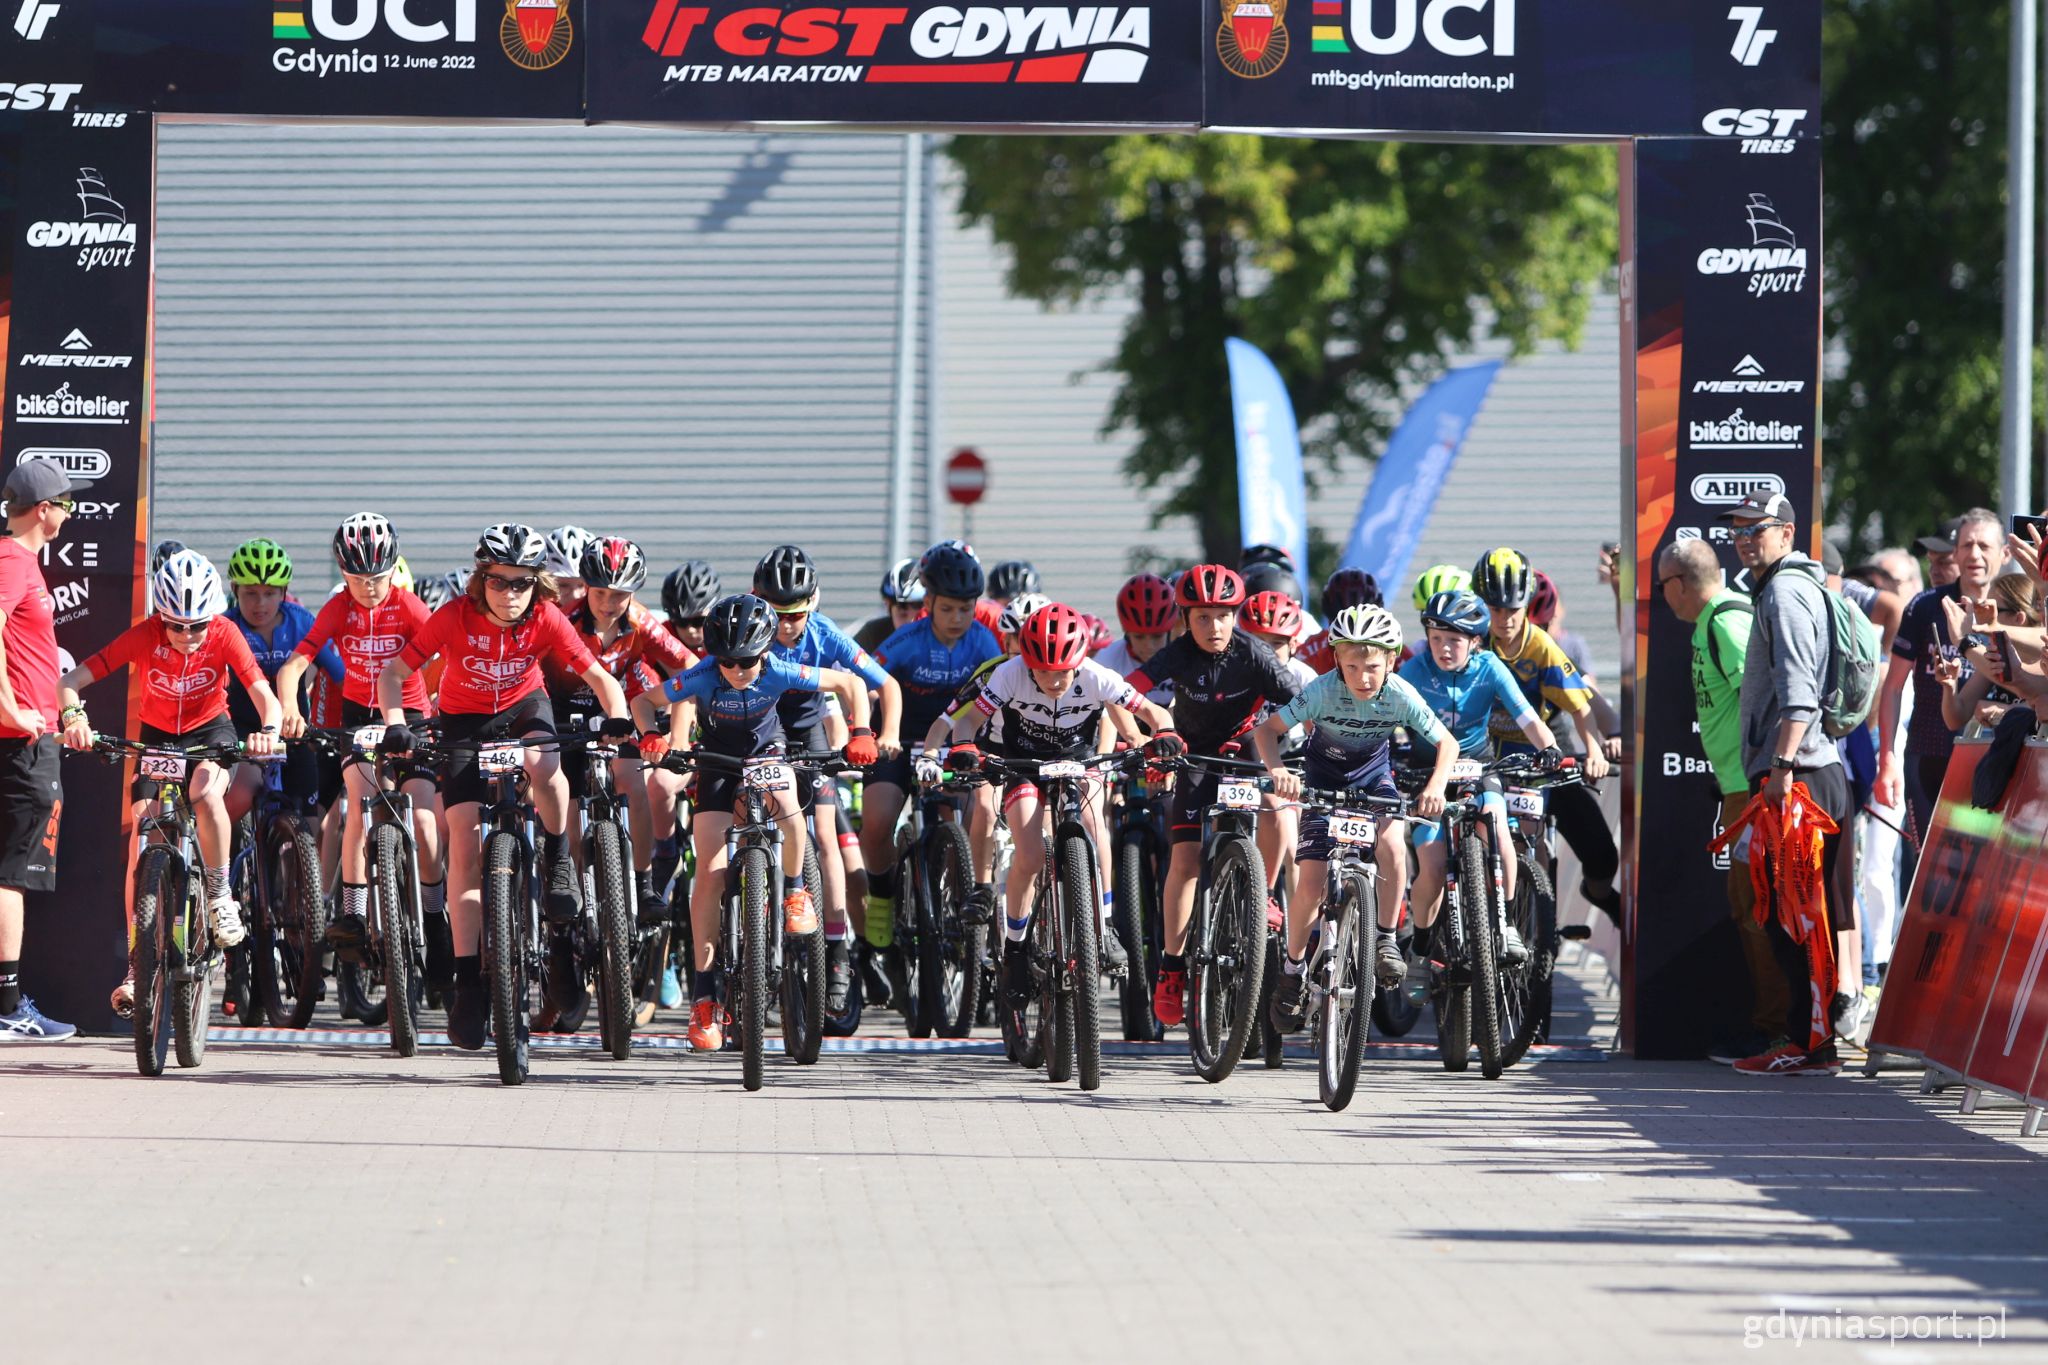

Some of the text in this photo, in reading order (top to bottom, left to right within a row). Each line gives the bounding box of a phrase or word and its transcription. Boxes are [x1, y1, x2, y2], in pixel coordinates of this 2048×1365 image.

[312, 0, 475, 42] UCI
[1351, 0, 1515, 56] UCI
[713, 8, 909, 57] CST
[909, 6, 1150, 59] GDYNIA
[272, 47, 475, 78] Gdynia 12 June 2022
[663, 65, 863, 82] MTB MARATON
[1311, 70, 1514, 92] mtbgdyniamaraton.pl
[72, 113, 128, 127] TIRES
[1702, 108, 1807, 137] CST
[1740, 139, 1796, 153] TIRES
[26, 221, 136, 248] GDYNIA
[77, 246, 136, 271] sport
[1697, 248, 1806, 274] GDYNIA
[1747, 268, 1806, 298] sport
[20, 354, 132, 367] MERIDA
[1692, 380, 1804, 393] MERIDA
[1016, 700, 1094, 719] TREK
[1340, 730, 1385, 739] TACTIC
[152, 760, 178, 774] 323
[490, 752, 517, 765] 486
[1228, 787, 1254, 801] 396
[1512, 796, 1537, 811] 436
[1339, 821, 1368, 838] 455
